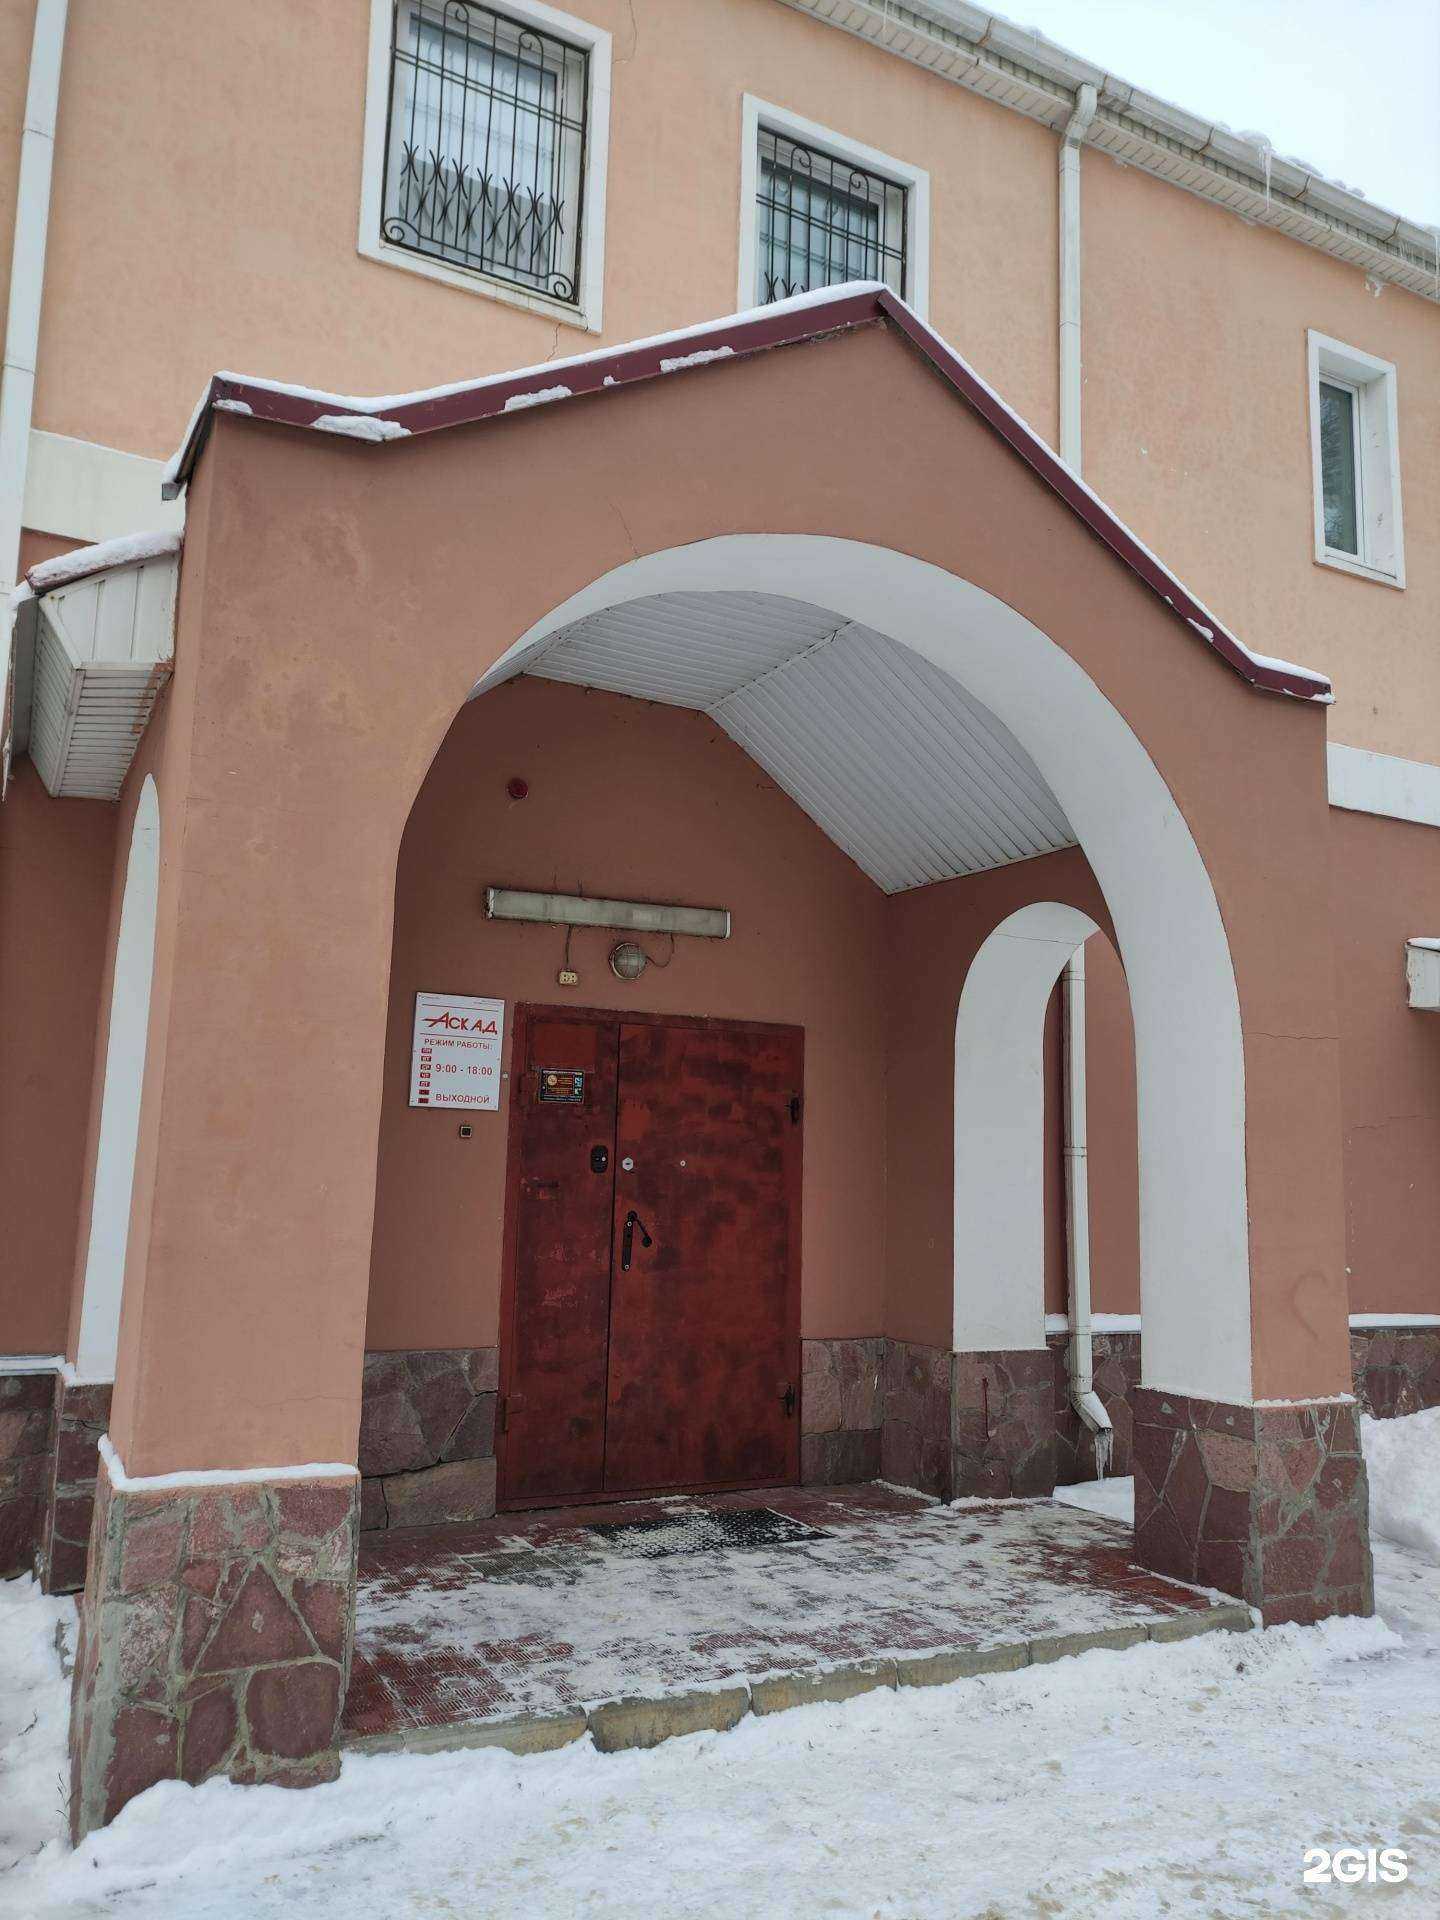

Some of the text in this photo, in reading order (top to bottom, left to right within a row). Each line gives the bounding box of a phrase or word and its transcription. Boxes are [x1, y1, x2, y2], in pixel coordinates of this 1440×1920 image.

[424, 1038, 455, 1047] РЕЖИМ
[435, 1063, 457, 1073] 9:00
[435, 1093, 490, 1103] ВЫХОДНОЙ
